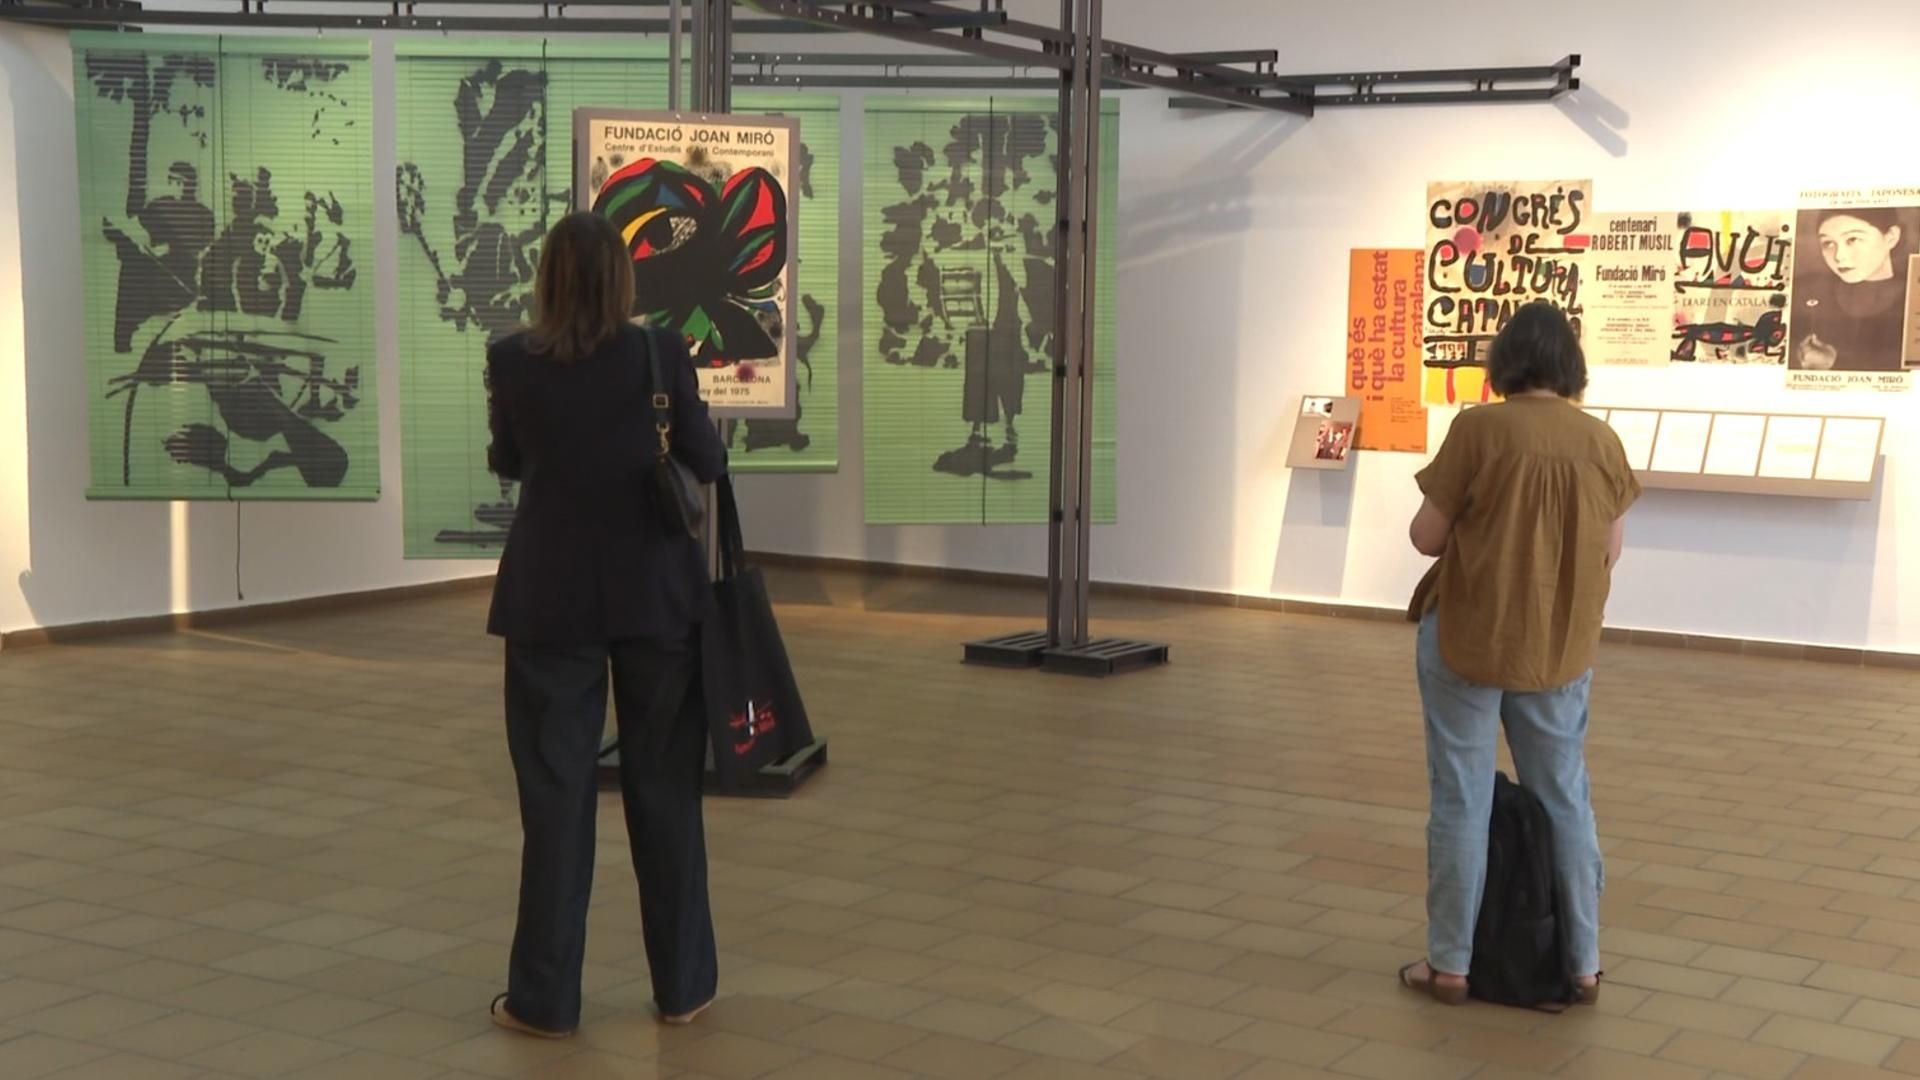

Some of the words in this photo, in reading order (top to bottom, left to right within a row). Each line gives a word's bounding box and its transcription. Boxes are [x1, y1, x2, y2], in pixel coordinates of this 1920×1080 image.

[604, 125, 683, 142] FUNDACIÓ
[689, 129, 730, 143] JOAN
[737, 129, 775, 145] MIRÓ
[604, 142, 635, 152] Centre
[1609, 215, 1657, 233] centenari
[1507, 233, 1585, 255] DE
[1592, 234, 1636, 251] ROBERT
[1639, 234, 1673, 251] MUSIL
[1373, 250, 1388, 310] estat
[1428, 239, 1583, 314] CULTURA
[1596, 265, 1638, 281] Fundació
[1641, 265, 1666, 281] Miró
[1409, 251, 1424, 348] catalana
[1368, 314, 1386, 342] ha
[1389, 279, 1407, 359] cultura
[1387, 363, 1404, 382] la
[1848, 375, 1872, 383] JOAN
[713, 387, 727, 396] del
[730, 387, 750, 396] 1975
